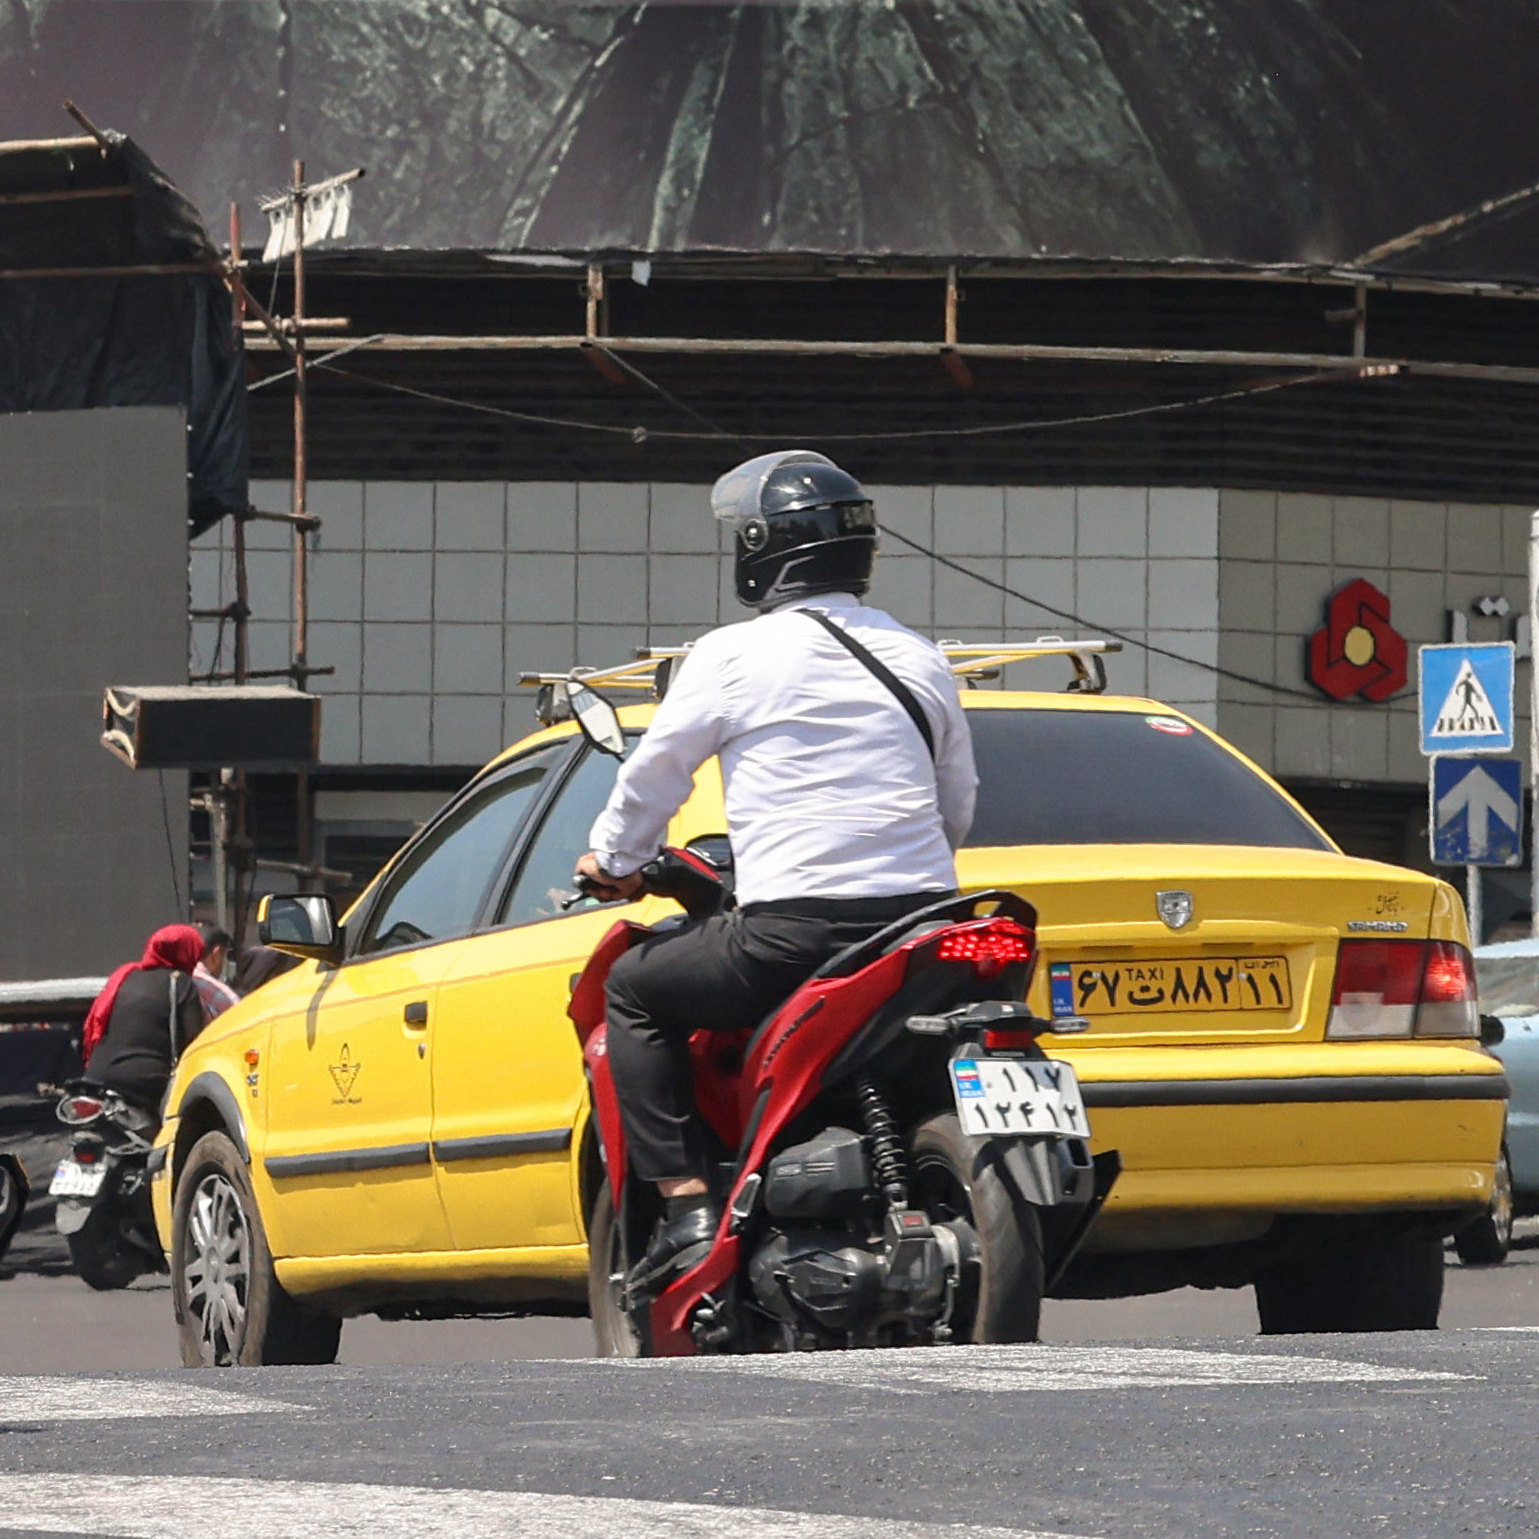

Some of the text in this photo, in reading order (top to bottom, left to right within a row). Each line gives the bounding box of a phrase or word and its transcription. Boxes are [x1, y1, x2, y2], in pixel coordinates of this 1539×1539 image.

[1125, 967, 1164, 981] TAXI
[1246, 972, 1284, 1006] ۱۱
[1002, 1066, 1061, 1093] ۱۱۷
[974, 1100, 1078, 1131] ۱۲۴۱۲
